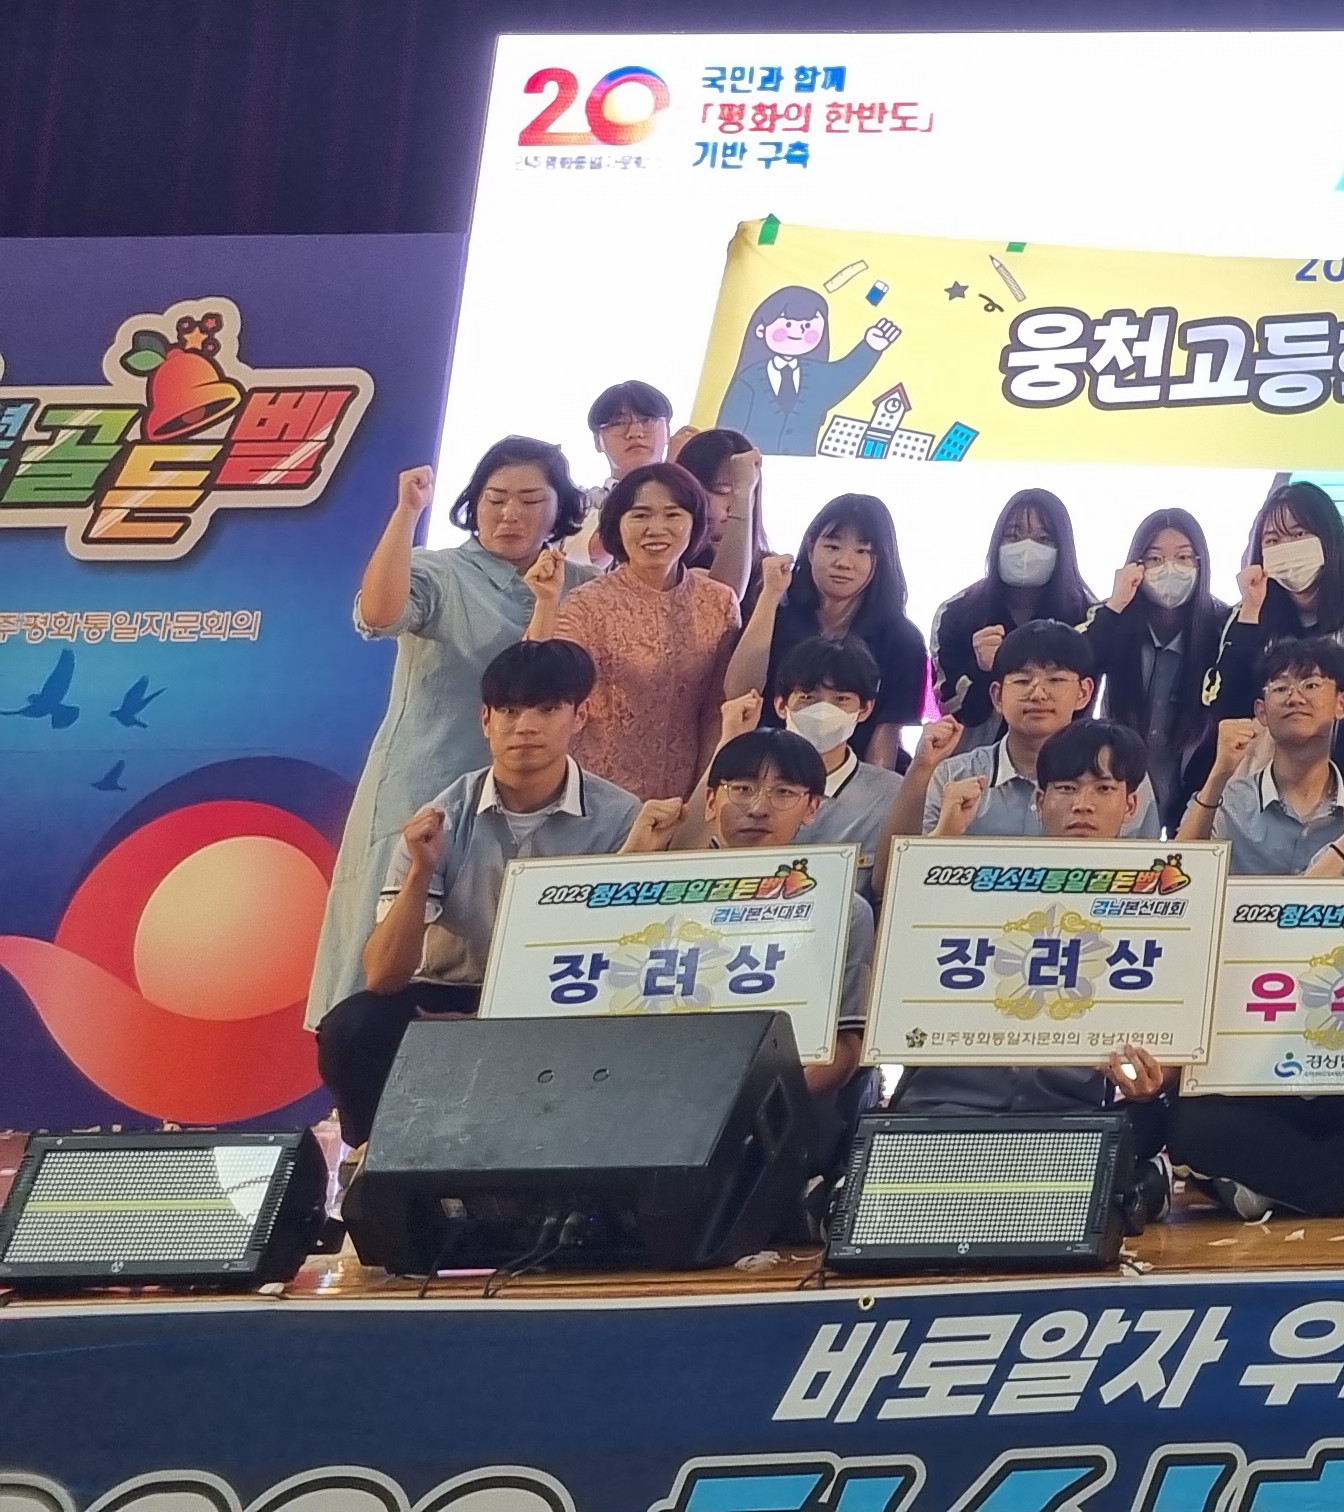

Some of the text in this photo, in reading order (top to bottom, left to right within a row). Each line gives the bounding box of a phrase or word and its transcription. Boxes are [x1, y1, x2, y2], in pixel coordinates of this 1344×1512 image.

[701, 65, 847, 93] 국민과 함께
[518, 65, 671, 146] 20
[693, 141, 748, 169] 기반
[757, 141, 810, 169] 구축
[711, 903, 814, 925] 경남본선대회
[1090, 898, 1189, 918] 경남본선대회
[771, 1304, 1234, 1425] 바로알자
